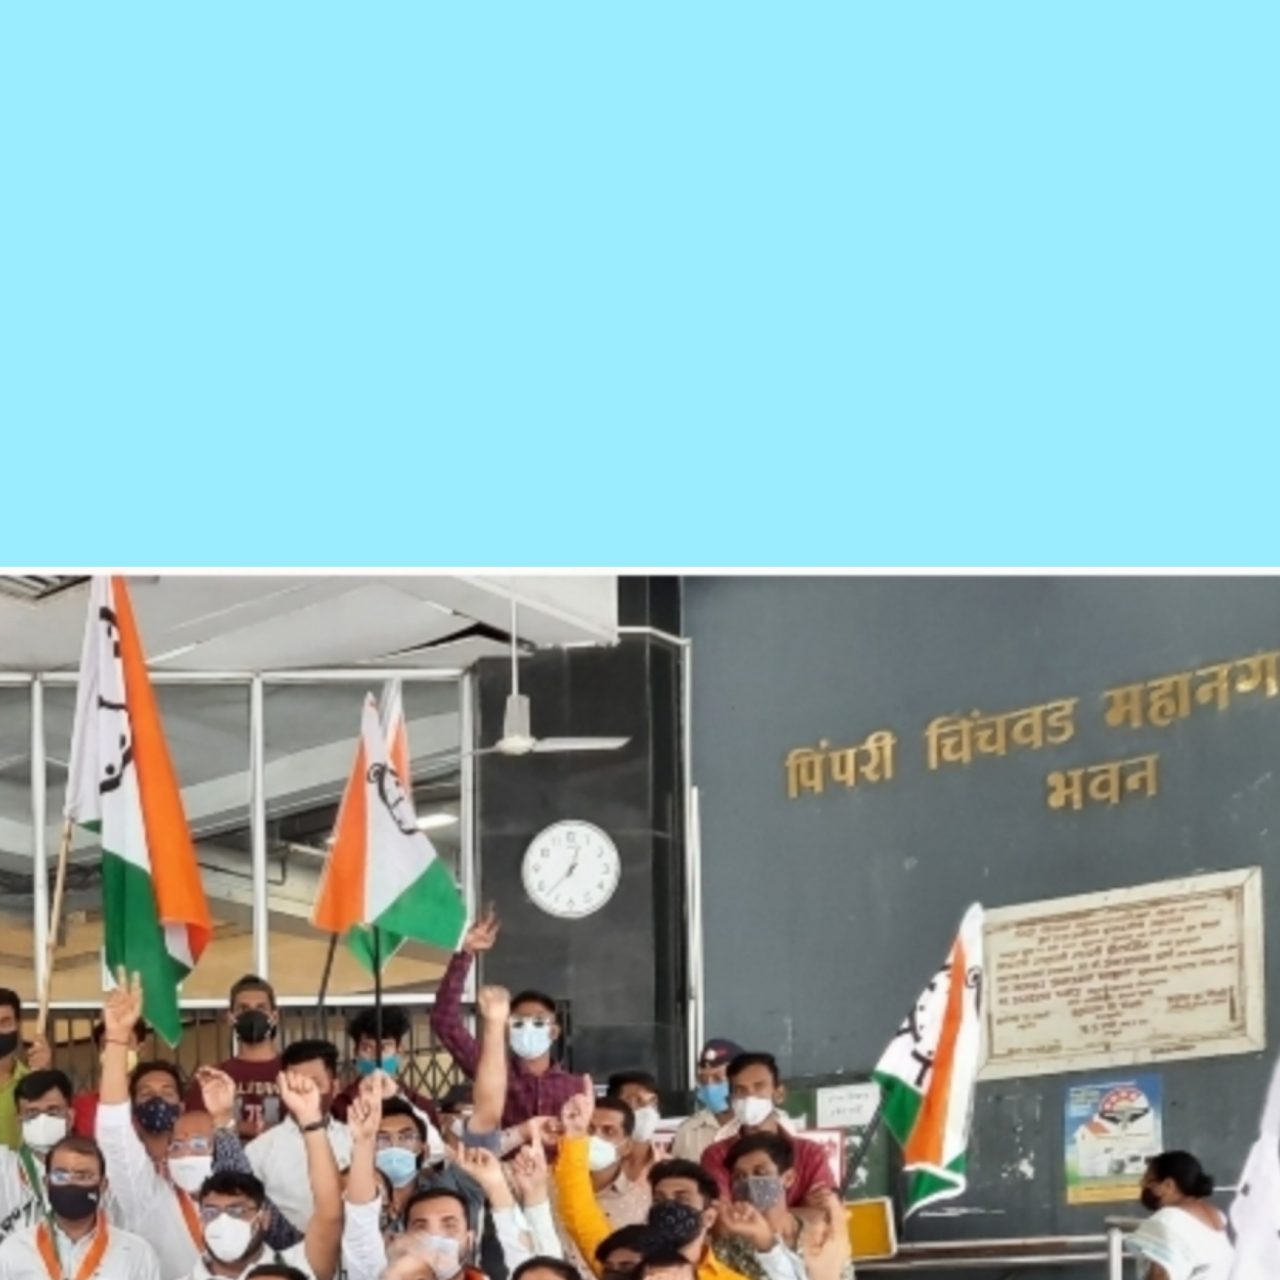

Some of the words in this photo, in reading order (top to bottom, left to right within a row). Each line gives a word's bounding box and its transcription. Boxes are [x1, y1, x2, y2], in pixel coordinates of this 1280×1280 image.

[785, 729, 898, 798] पिंपरी
[925, 697, 1079, 771] चिंचवड
[1046, 753, 1161, 810] भवन
